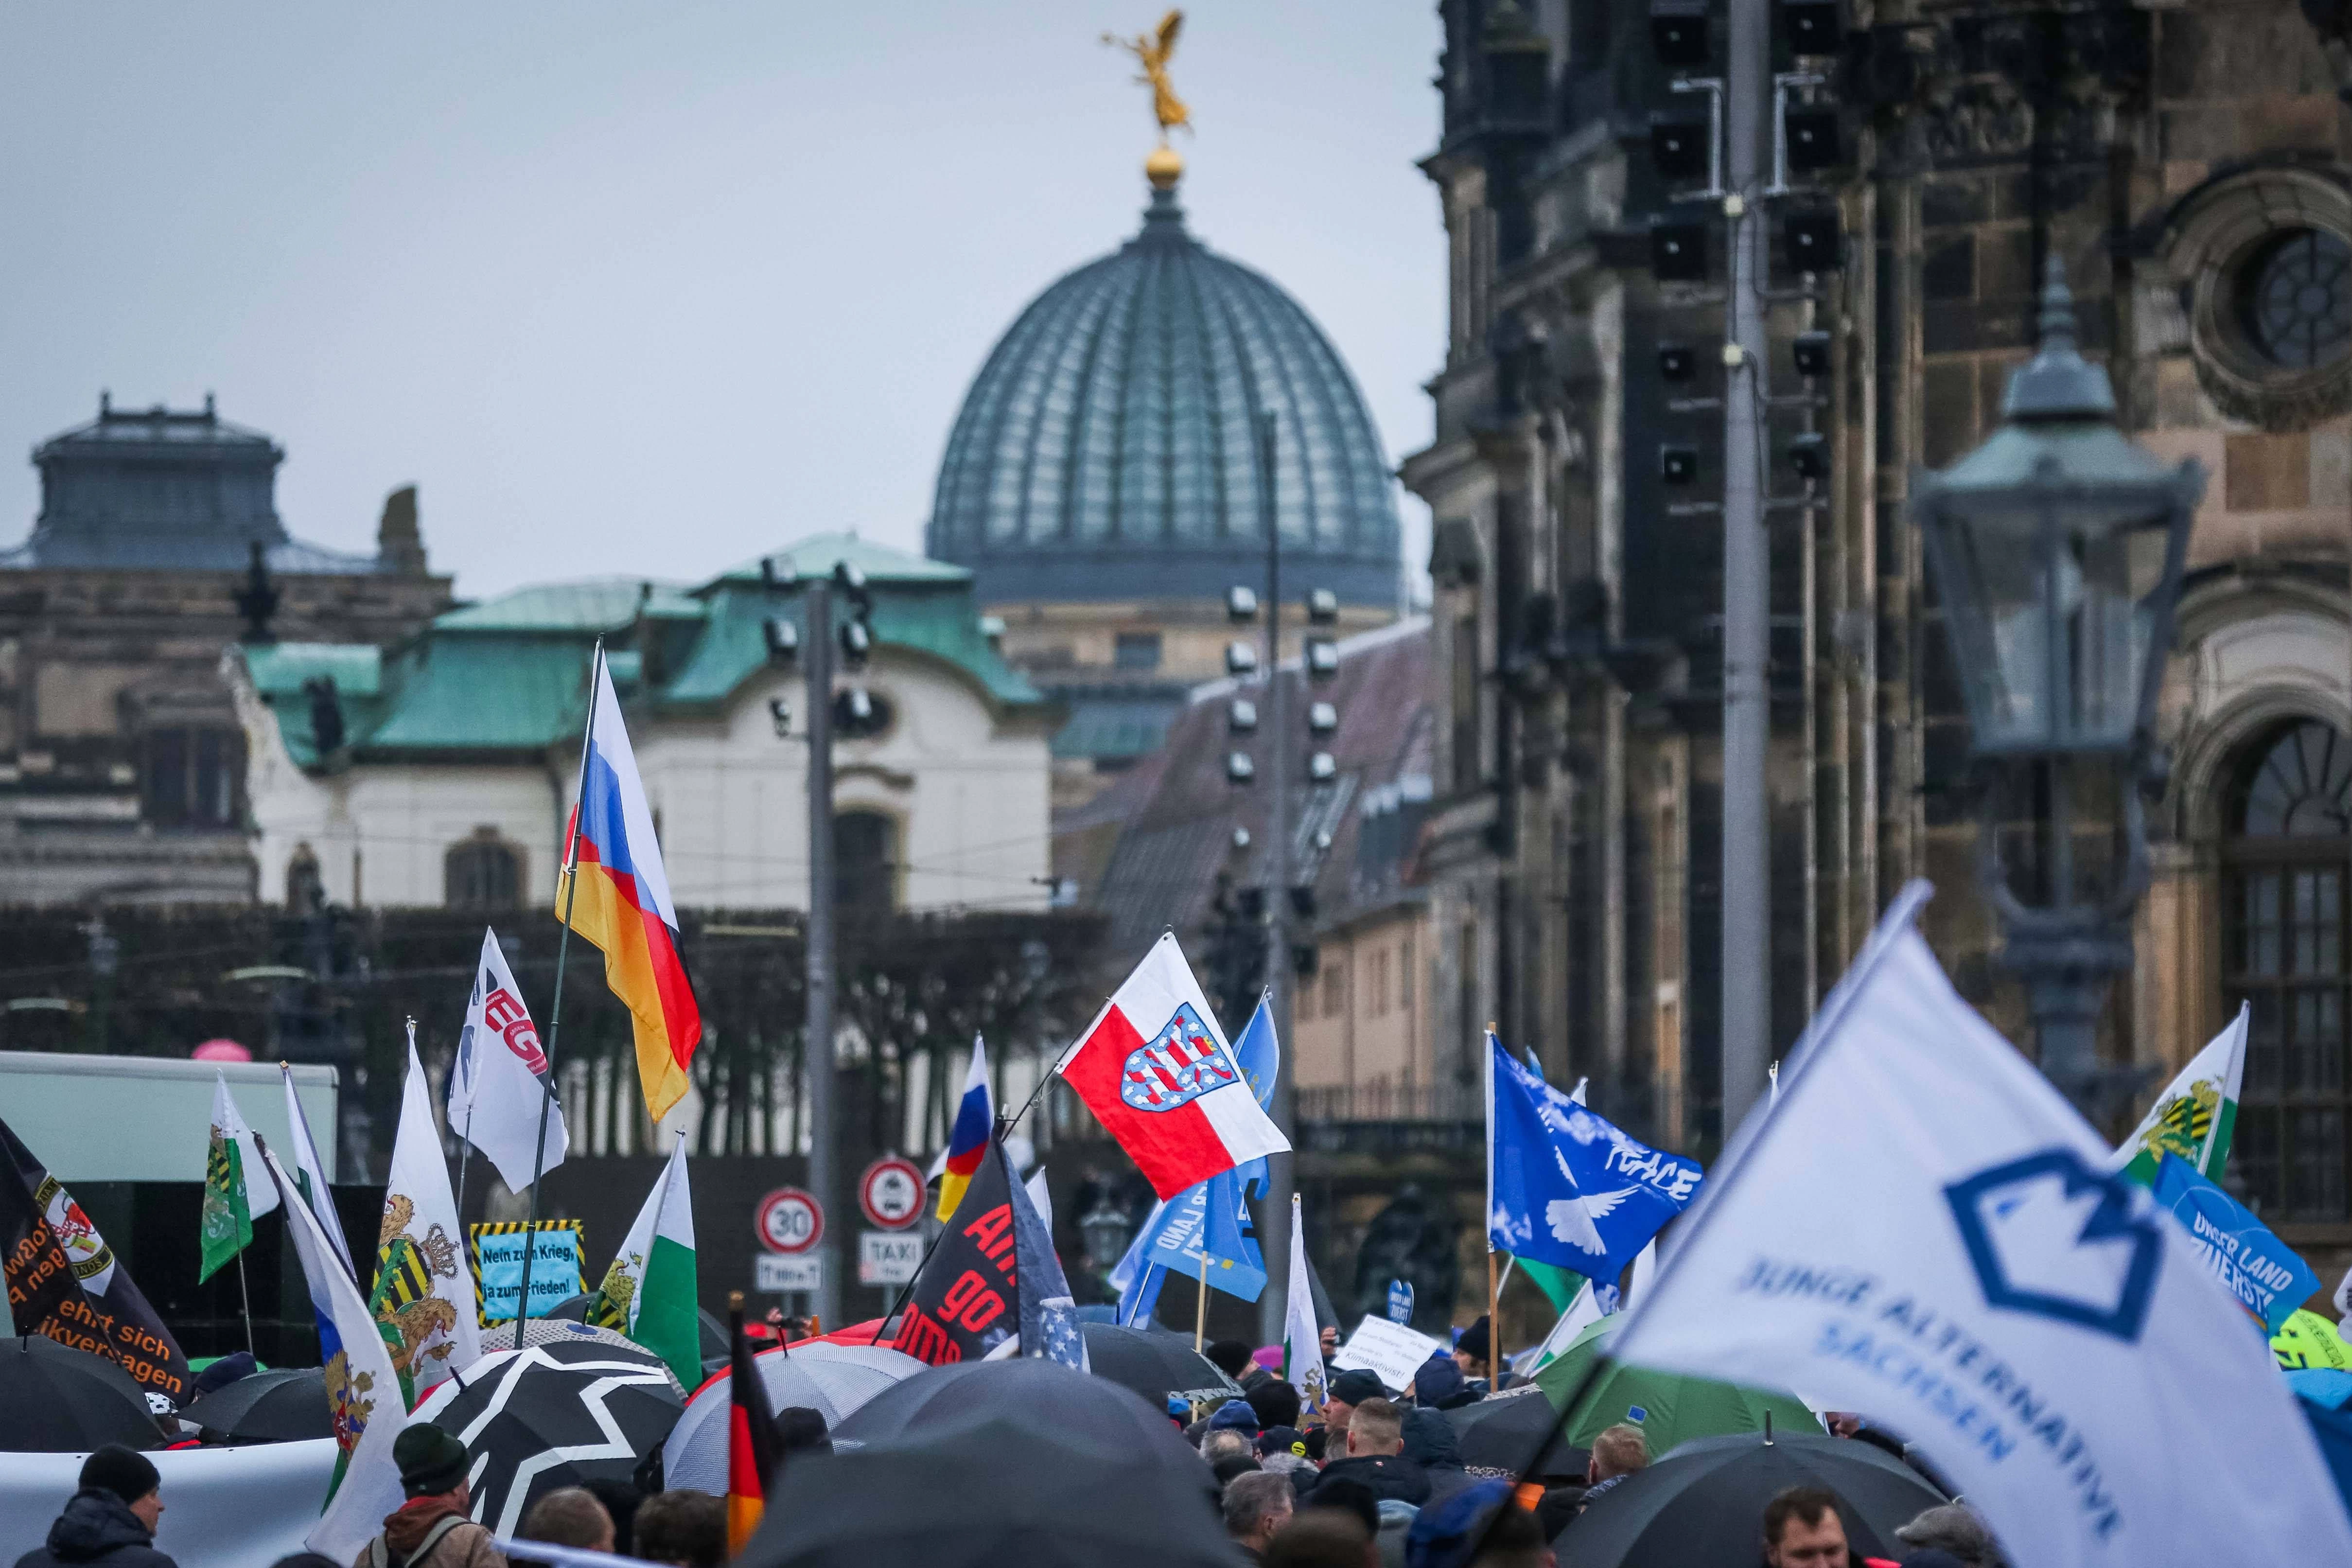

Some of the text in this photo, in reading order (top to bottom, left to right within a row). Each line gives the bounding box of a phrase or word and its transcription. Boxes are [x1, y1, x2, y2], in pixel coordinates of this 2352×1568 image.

[774, 1209, 809, 1237] 30
[483, 1246, 510, 1264] Nein
[539, 1244, 574, 1262] Krieg,
[871, 1241, 916, 1261] TAXI
[2194, 1211, 2293, 1291] UNSER LAND
[482, 1284, 495, 1302] ja
[528, 1278, 570, 1295] rieden!
[119, 1323, 170, 1361] sich
[1345, 1351, 1405, 1379] Klimaaktivist!
[1816, 1322, 2015, 1462] SACHSEN
[1881, 1296, 2124, 1541] ALTERNATIVE
